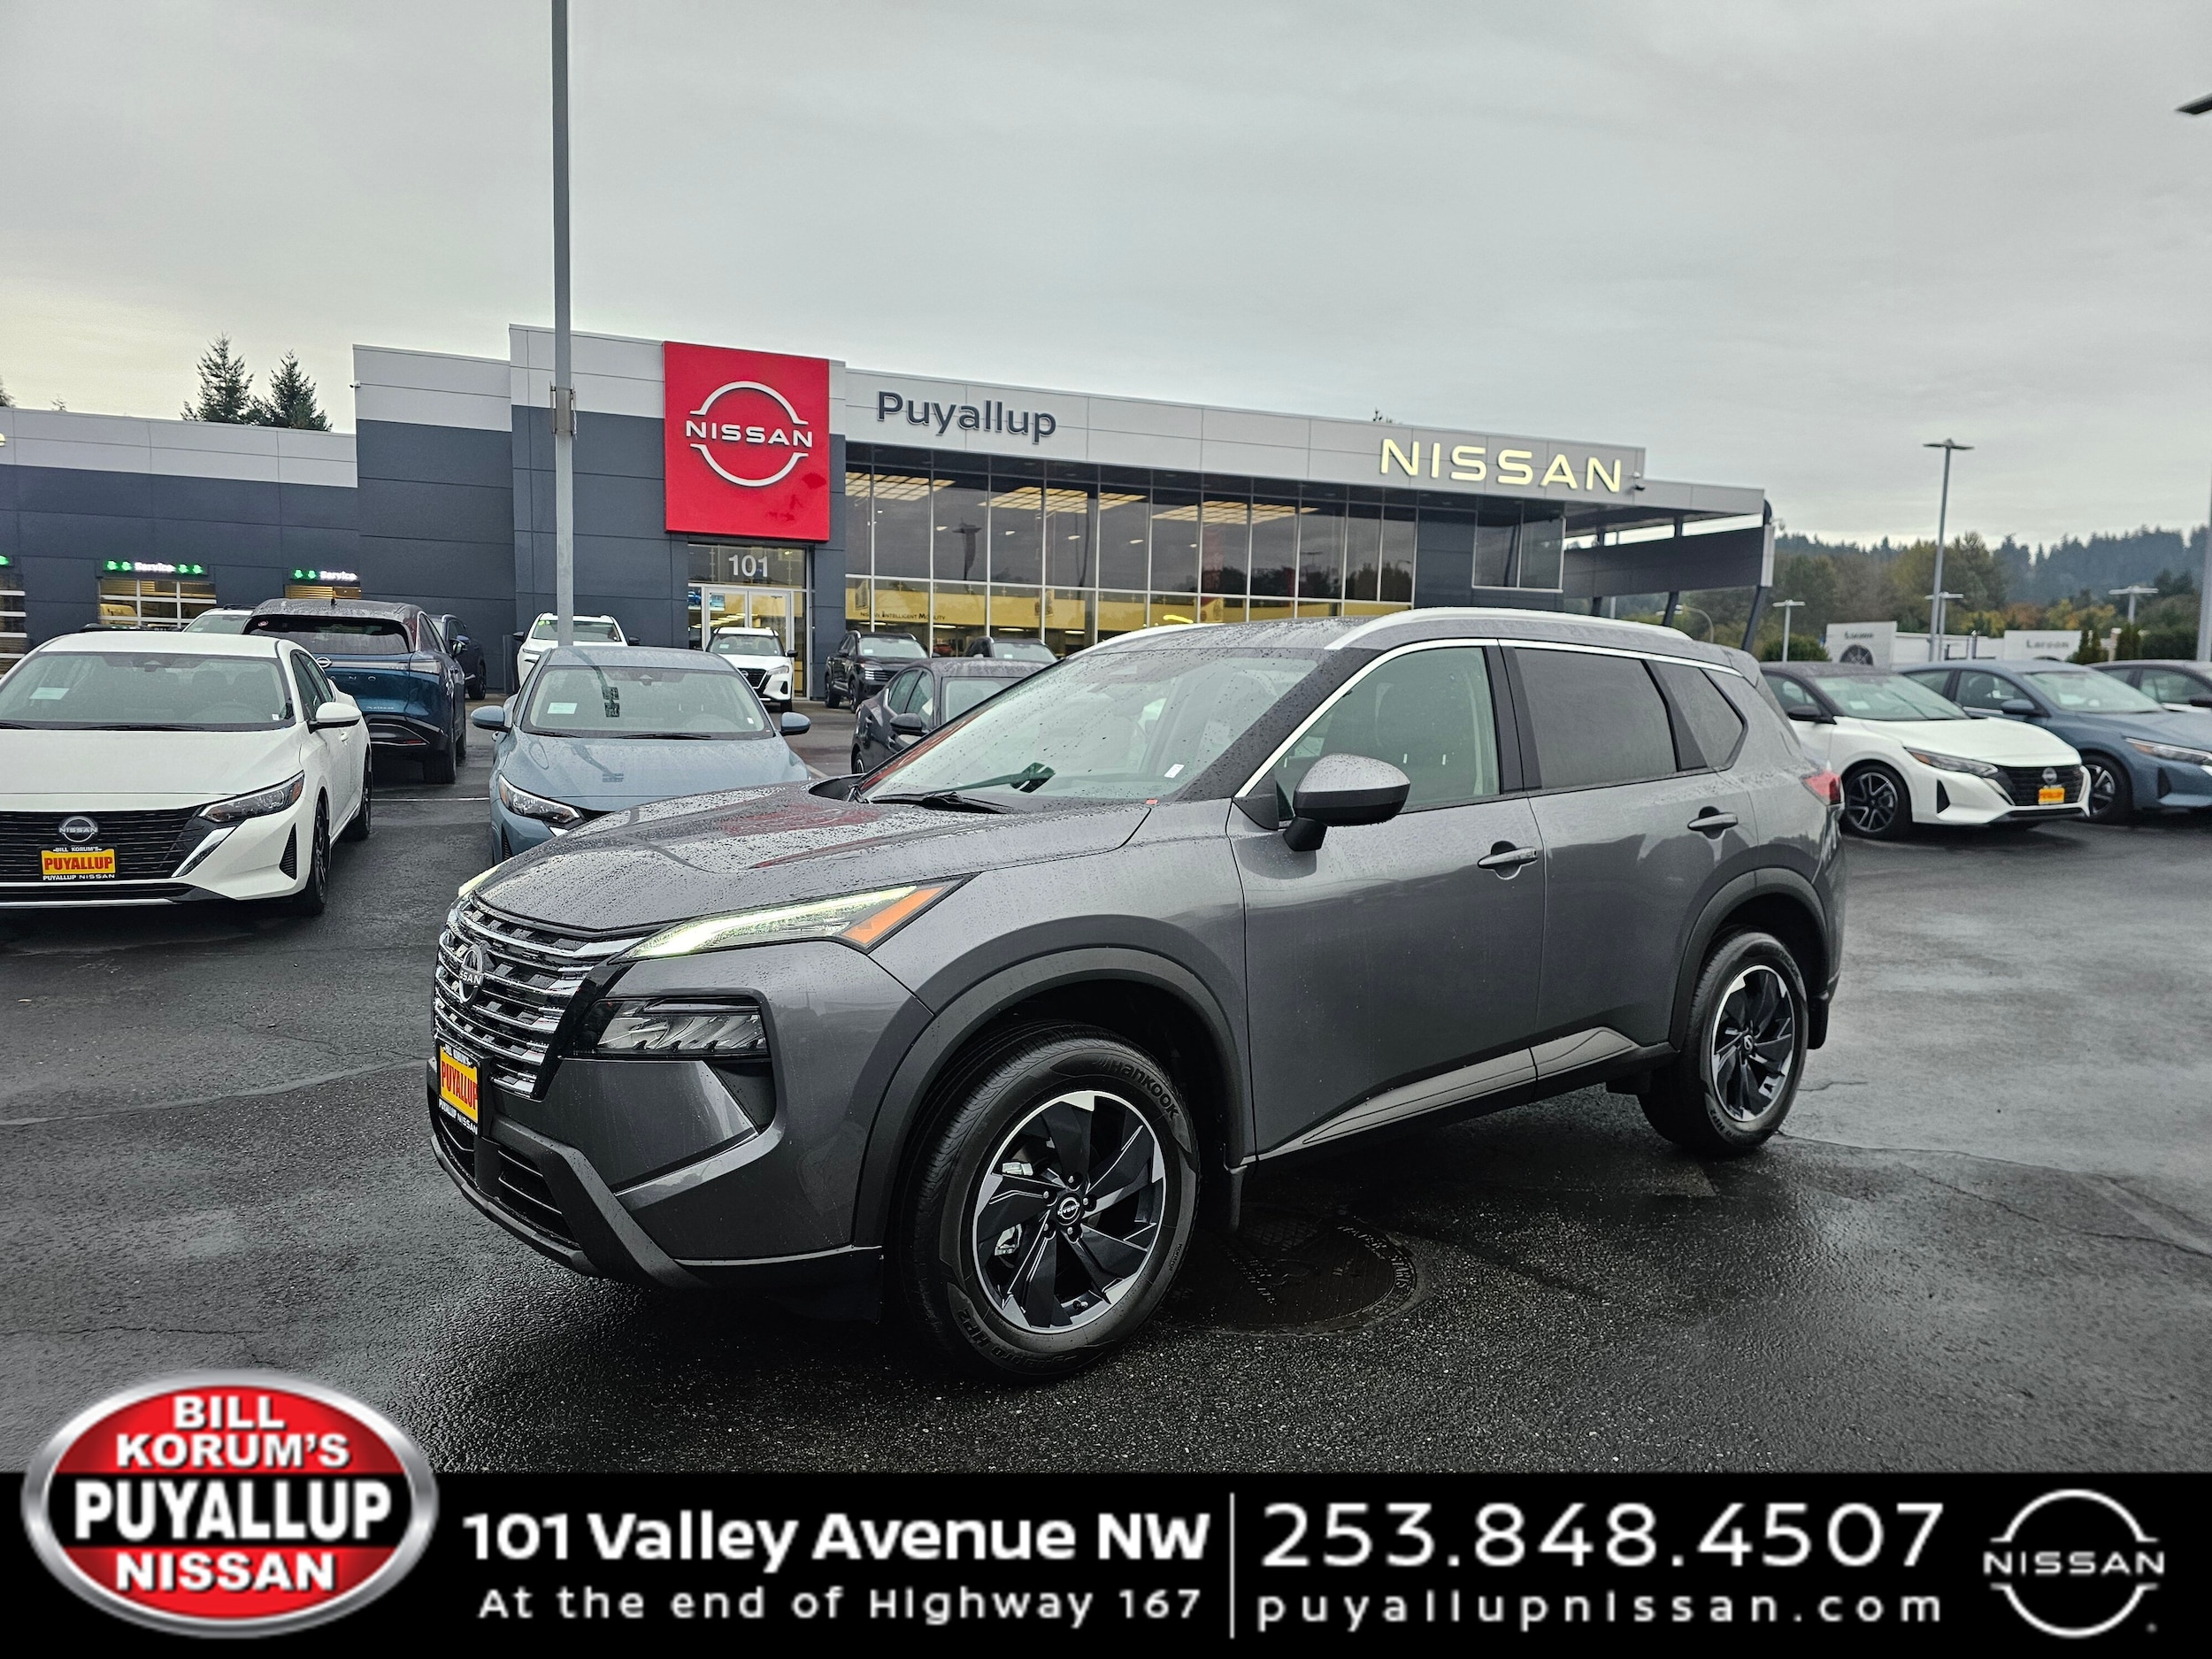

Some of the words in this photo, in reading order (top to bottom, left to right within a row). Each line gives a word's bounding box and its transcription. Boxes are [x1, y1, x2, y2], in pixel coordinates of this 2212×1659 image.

[876, 390, 1057, 444] Puyallup
[686, 419, 814, 448] NISSAN
[1380, 438, 1621, 493] NISSAN
[728, 554, 768, 578] 101
[44, 856, 113, 871] PUYALLUP
[441, 1060, 480, 1110] PUYALLUP
[457, 1112, 479, 1135] NISSAN
